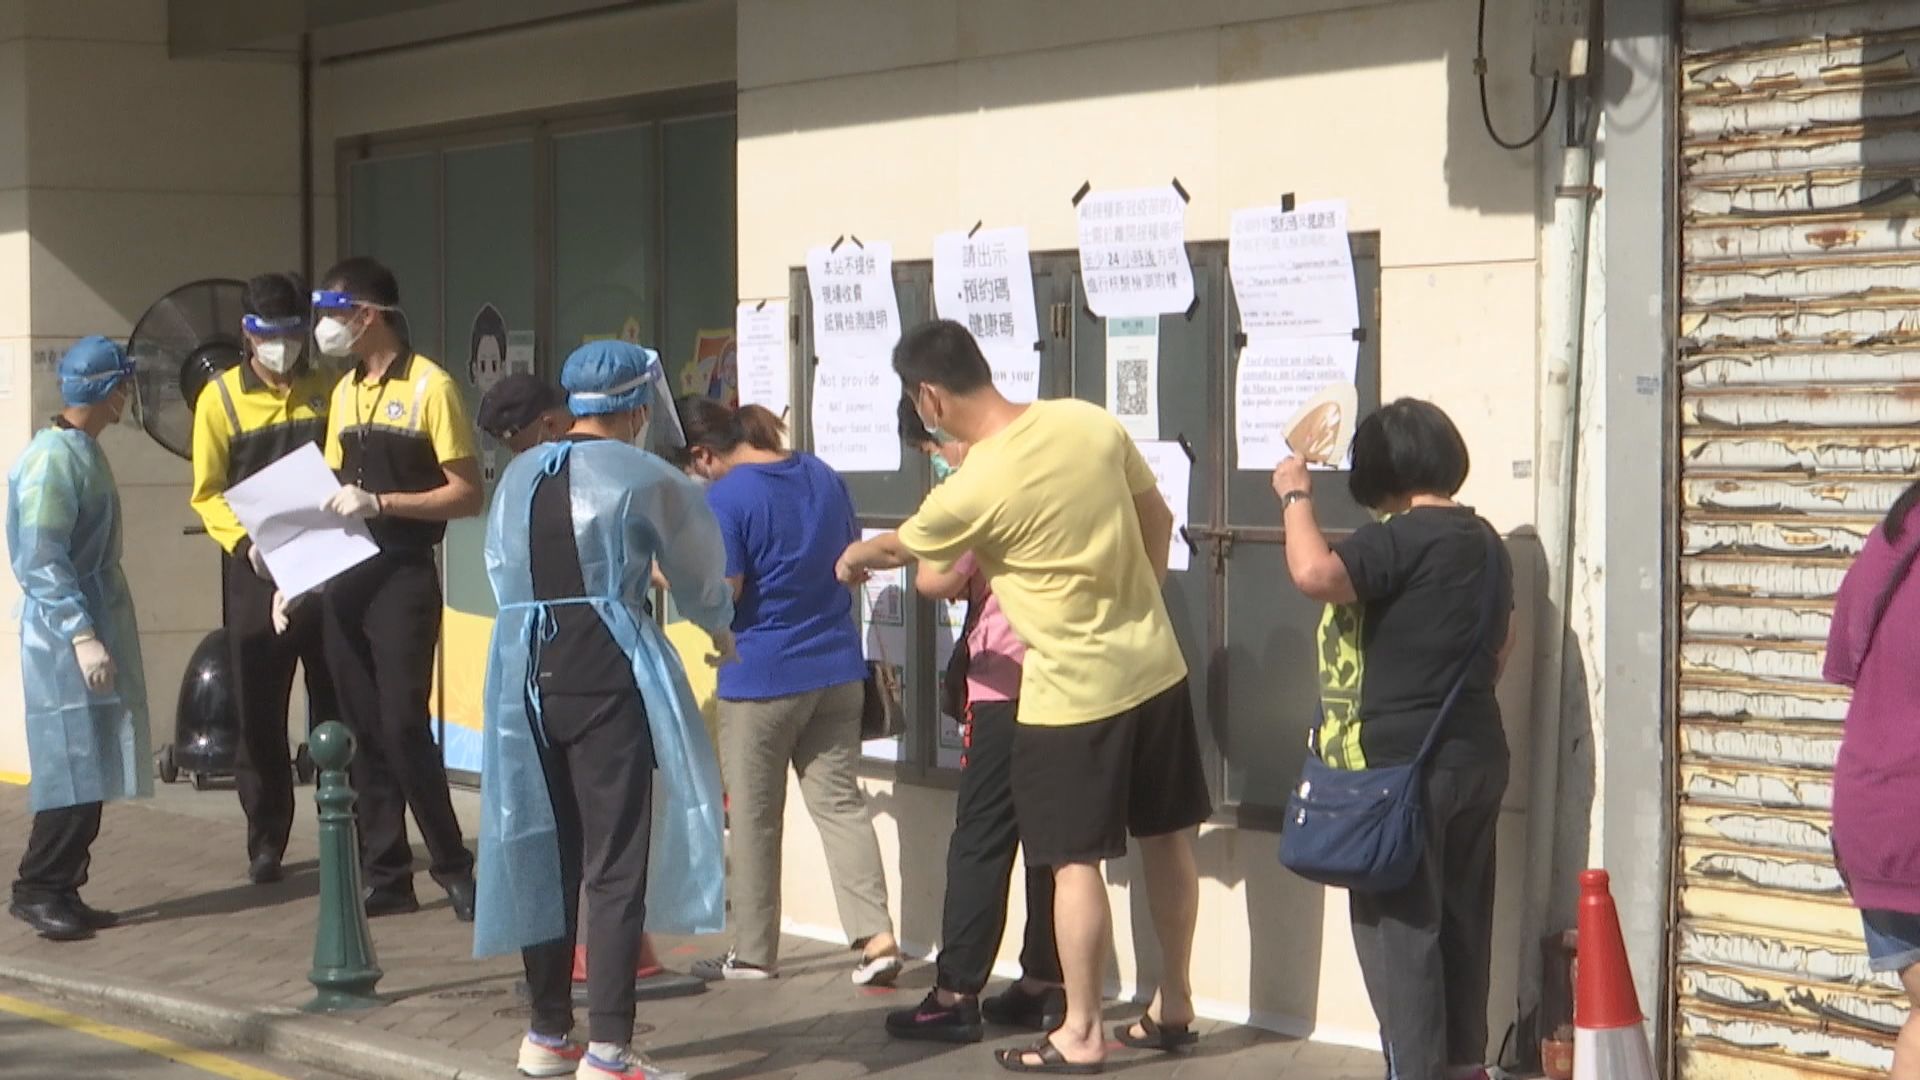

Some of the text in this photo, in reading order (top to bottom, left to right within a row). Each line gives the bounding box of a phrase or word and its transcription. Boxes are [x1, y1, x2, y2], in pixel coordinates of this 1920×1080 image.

[823, 255, 876, 276] 本站不提供
[962, 242, 1008, 269] 請出示
[822, 284, 863, 304] 現場收費
[963, 276, 1011, 303] 預約碼
[968, 312, 1015, 339] 健康碼
[820, 370, 880, 389] Not provide
[1010, 370, 1035, 386] your
